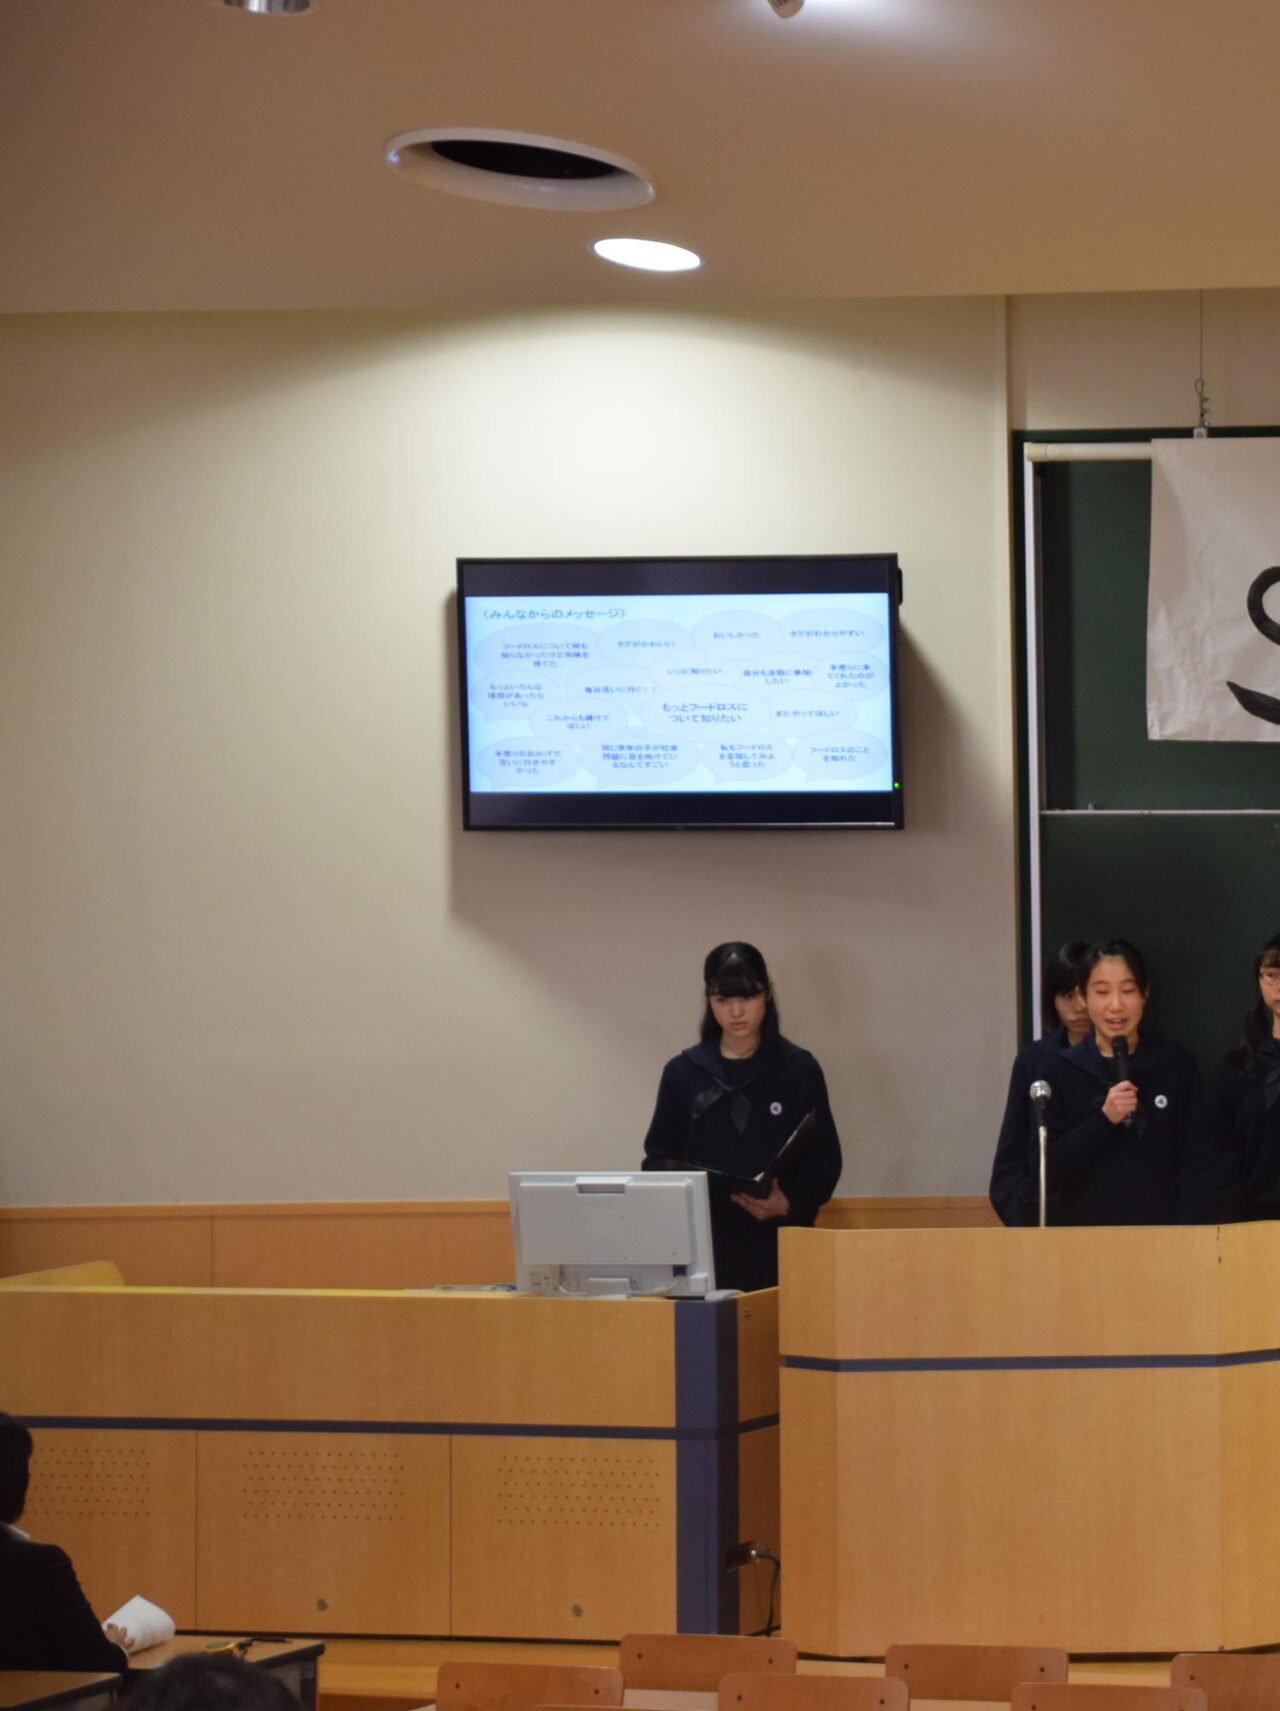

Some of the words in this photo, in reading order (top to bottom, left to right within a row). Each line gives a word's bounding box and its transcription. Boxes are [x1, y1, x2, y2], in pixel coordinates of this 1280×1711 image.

[661, 702, 750, 712] もっとフードロスに
[668, 714, 743, 723] ついて知りたい
